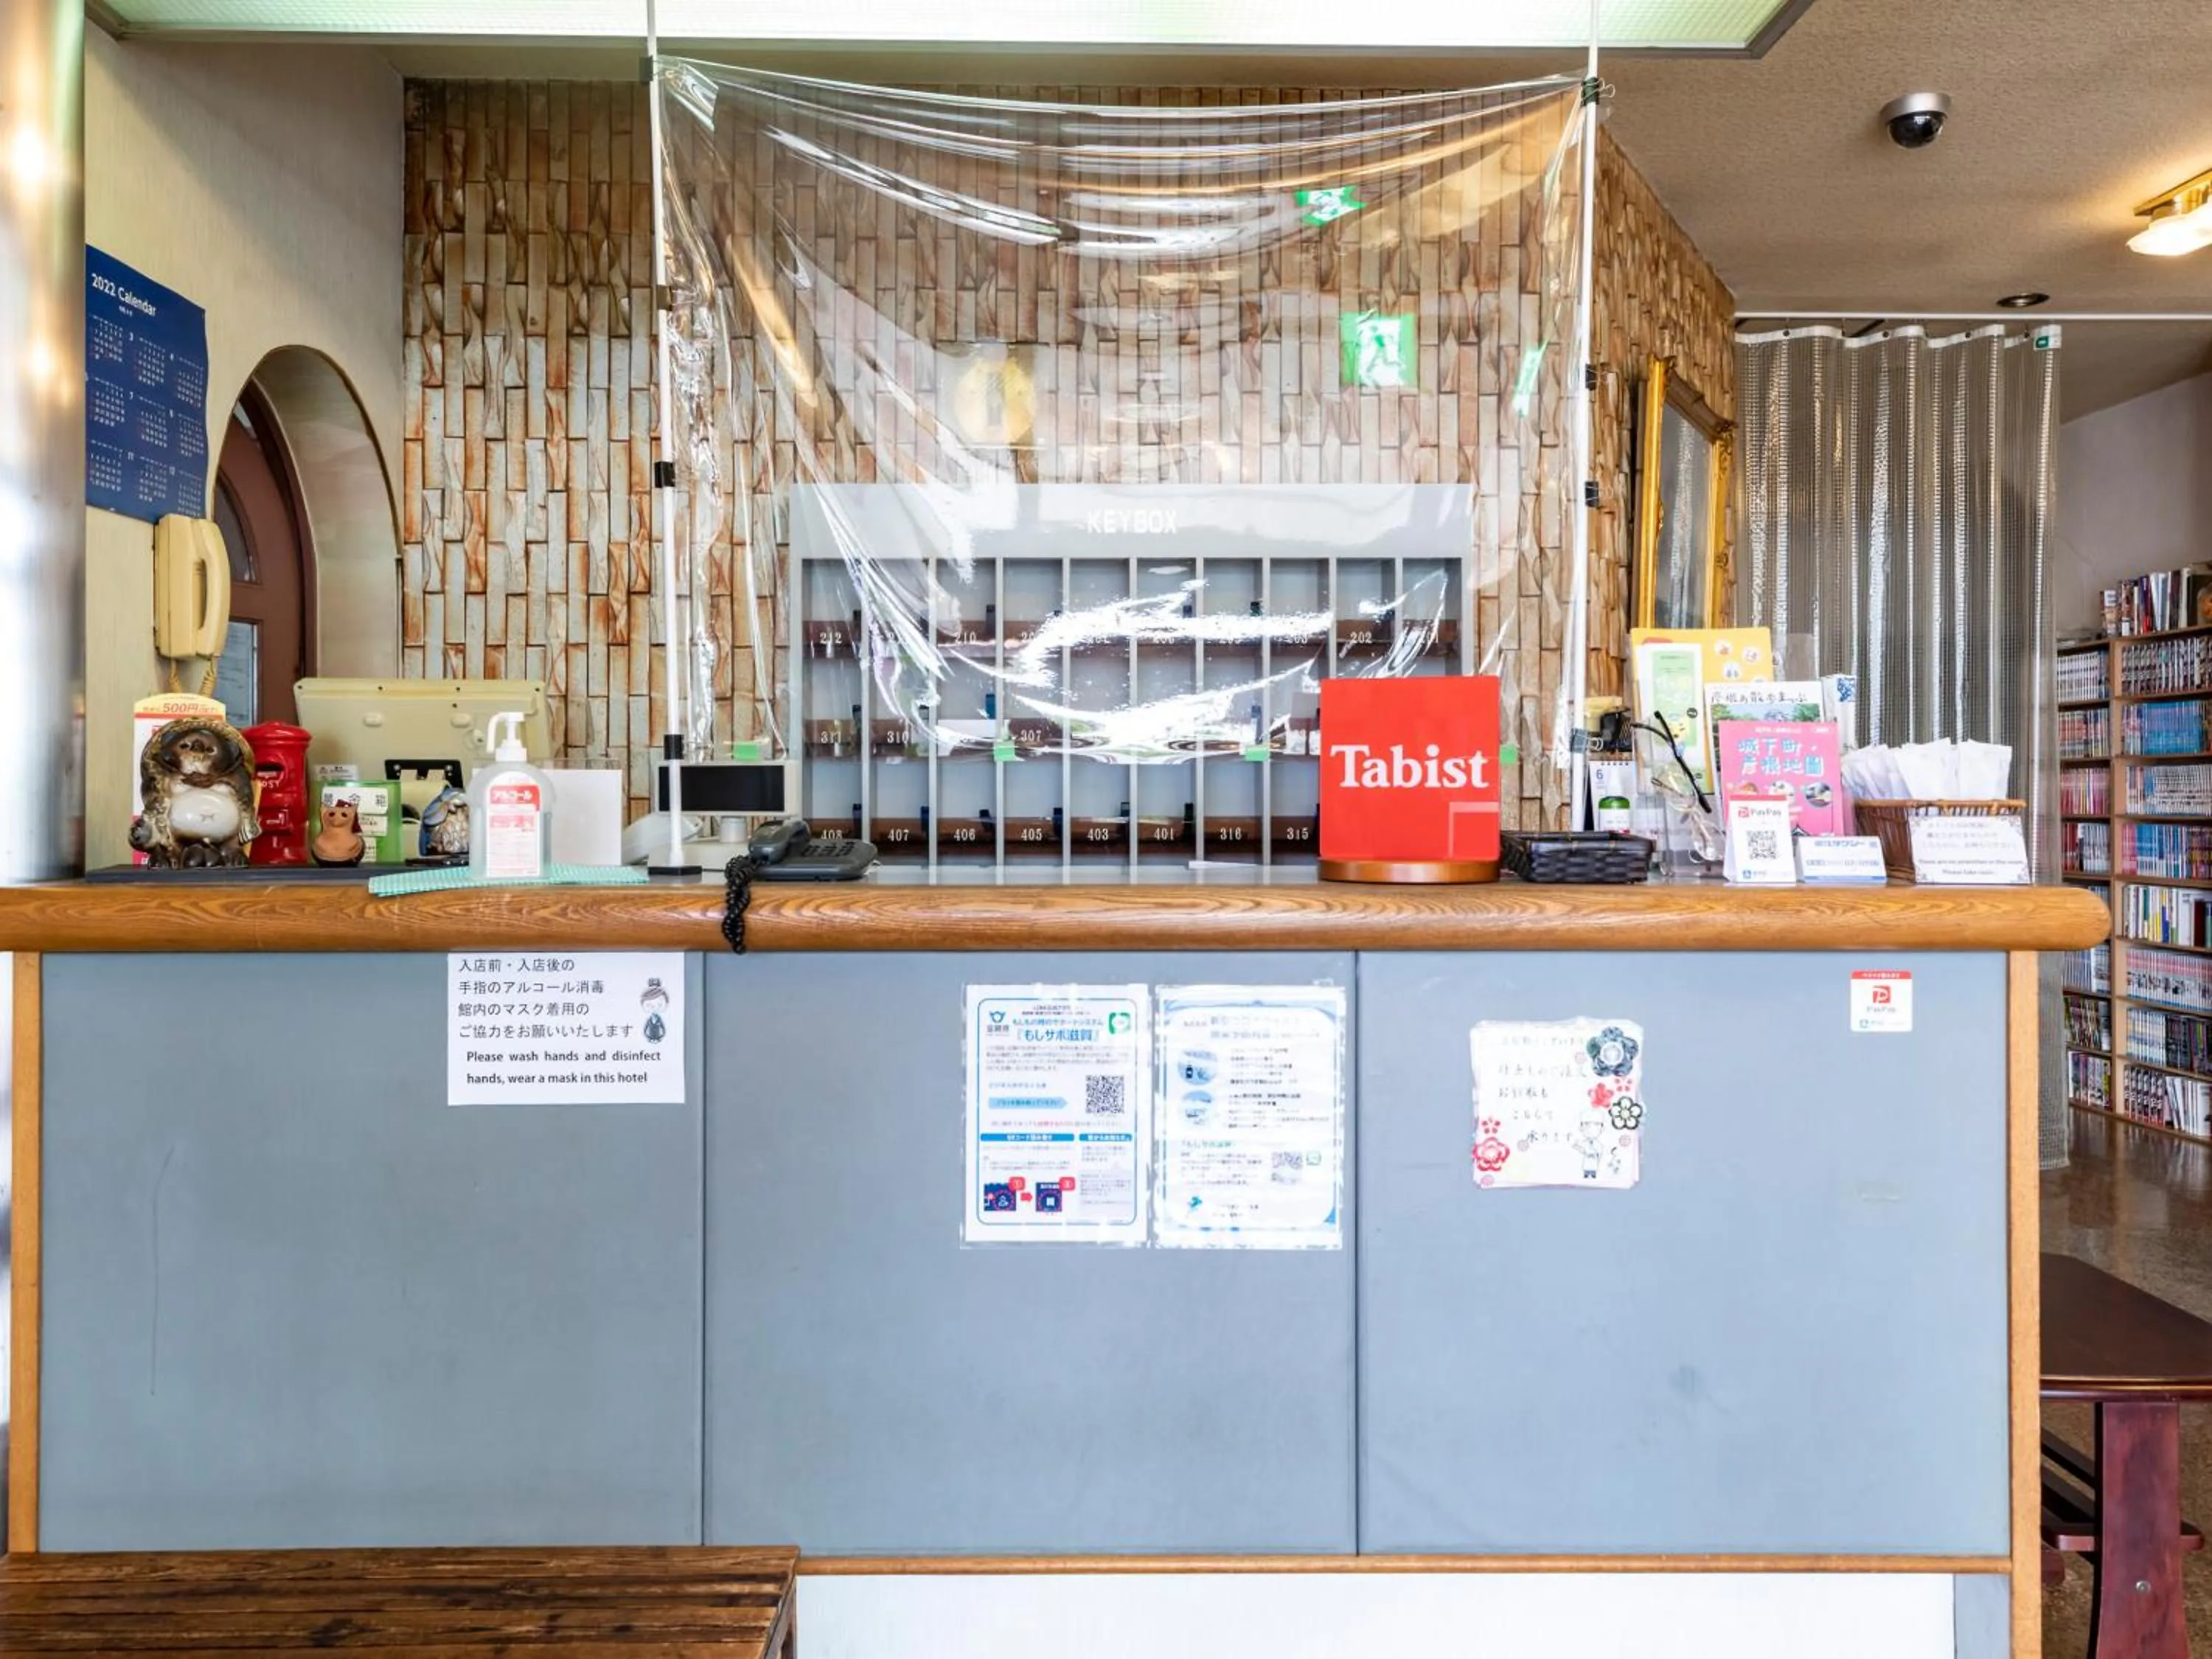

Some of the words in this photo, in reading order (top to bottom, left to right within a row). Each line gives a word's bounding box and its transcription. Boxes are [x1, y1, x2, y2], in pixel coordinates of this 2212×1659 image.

[91, 274, 115, 296] 2022
[118, 287, 156, 316] Calendar
[1087, 508, 1178, 534] KEYBOX
[1350, 630, 1372, 644] 202
[887, 731, 909, 744] 310
[1020, 729, 1042, 742] 307
[1329, 744, 1489, 789] Tabist
[1596, 768, 1604, 779] 6
[821, 830, 843, 841] 408
[888, 829, 909, 841] 407
[953, 829, 976, 841] 406
[1020, 829, 1043, 841] 405
[1088, 829, 1109, 841] 403
[1153, 829, 1175, 841] 401
[1220, 827, 1242, 840] 316
[1287, 827, 1309, 840] 315
[458, 959, 574, 973] 入店前・入店後の
[459, 980, 605, 995] 手指のアルコール消毒
[458, 1003, 589, 1017] 館内のマスク着用の
[459, 1024, 633, 1039] ご協力をお願いいたします
[467, 1051, 504, 1062] Please
[509, 1051, 539, 1062] wash
[545, 1051, 579, 1062] hands
[585, 1051, 606, 1062] and
[612, 1051, 661, 1062] disinfect
[467, 1073, 505, 1085] hands,
[509, 1075, 535, 1083] wear
[548, 1073, 577, 1083] mask
[580, 1073, 591, 1083] in
[594, 1072, 616, 1083] this
[618, 1072, 648, 1083] hotel
